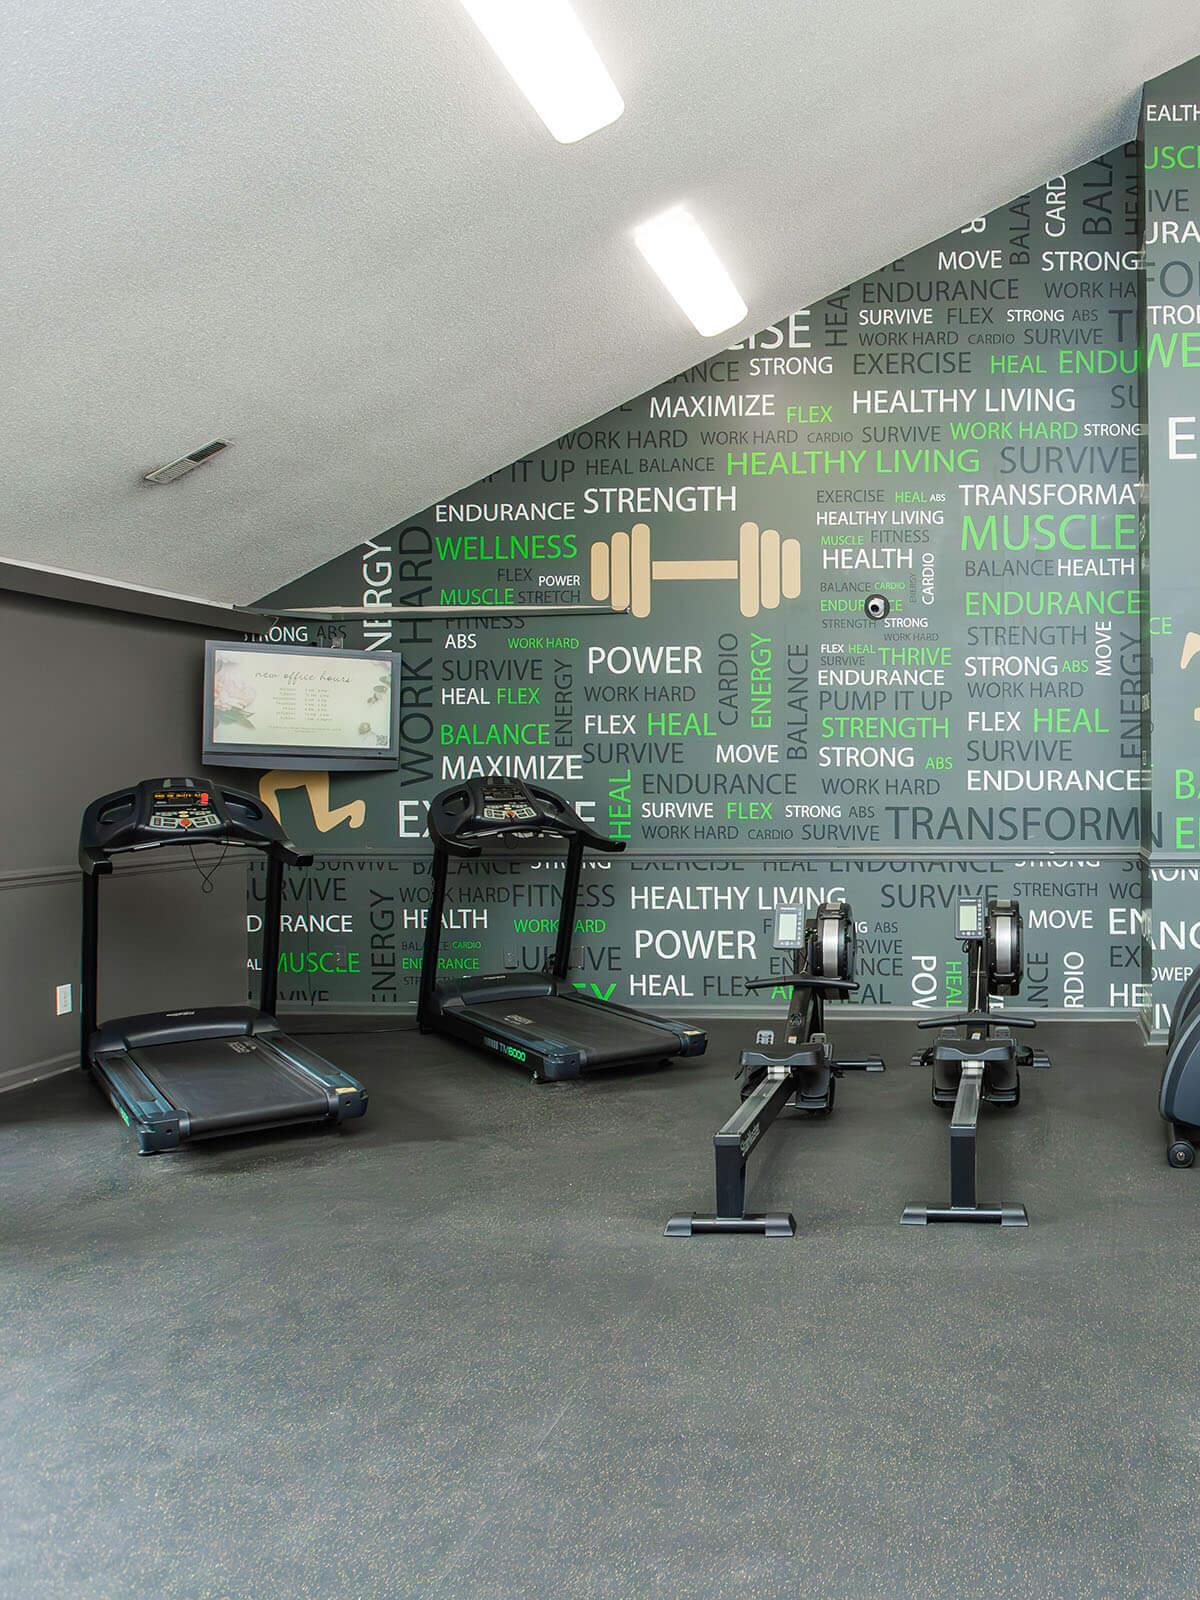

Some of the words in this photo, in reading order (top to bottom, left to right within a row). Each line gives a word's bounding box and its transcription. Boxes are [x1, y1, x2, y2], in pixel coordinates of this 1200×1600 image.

[938, 251, 1002, 269] MOVE
[1042, 251, 1139, 271] STRONG
[863, 279, 1019, 303] ENDURANCE
[1045, 282, 1103, 298] WORK
[859, 309, 933, 326] SURVIVE
[946, 308, 993, 324] FLEX
[1007, 309, 1064, 322] STRONG
[1073, 309, 1098, 322] ABS
[858, 332, 910, 345] WORK
[912, 331, 959, 345] HARD
[968, 334, 1014, 345] CARDIO
[1024, 329, 1103, 345] SURVIVE
[750, 357, 832, 376] STRONG
[853, 353, 971, 374] EXERCISE
[991, 355, 1047, 374] HEAL
[650, 394, 775, 418] MAXIMIZE
[852, 390, 976, 413] HEALTHY
[985, 388, 1076, 412] LIVING
[557, 431, 621, 450] WORK
[628, 429, 688, 448] HARD
[701, 431, 750, 445] WORK
[753, 430, 798, 444] HARD
[862, 426, 941, 443] SURVIVE
[950, 422, 1011, 440] WORK
[1019, 421, 1078, 438] HARD
[1084, 424, 1142, 436] STRONG
[585, 459, 633, 476] HEAL
[639, 457, 714, 473] BALANCE
[727, 451, 867, 476] HEALTHY
[877, 449, 980, 473] LIVING
[1000, 446, 1138, 474] SURVIVE
[511, 460, 533, 483] IT
[541, 459, 575, 482] UP
[583, 486, 737, 514] STRENGTH
[816, 489, 884, 503] EXERCISE
[895, 491, 927, 503] HEAL
[436, 503, 575, 523] ENDURANCE
[816, 512, 886, 526] HEALTHY
[891, 511, 944, 525] LIVING
[821, 536, 865, 545] MUSCLE
[870, 529, 929, 543] FITNESS
[961, 514, 1137, 550] MUSCLE
[436, 534, 577, 561] WELLNESS
[822, 549, 912, 569] HEALTH
[964, 560, 1054, 576] BALANCE
[1058, 558, 1135, 576] HEALTH
[497, 568, 533, 582] FLEX
[538, 575, 580, 587] POWER
[922, 553, 935, 605] CARDIO
[820, 581, 871, 593] BALANCE
[440, 589, 514, 606] MUSCLE
[518, 590, 580, 604] STRETCH
[966, 590, 1149, 616] ENDURANCE
[445, 634, 476, 649] ABS
[507, 638, 543, 649] WORK
[546, 637, 579, 649] HARD
[884, 633, 910, 641] WORK
[912, 633, 938, 641] HARD
[967, 626, 1087, 646] STRENGTH
[1096, 621, 1111, 676] MOVE
[588, 646, 702, 674] POWER
[718, 633, 738, 725] CARDIO
[751, 632, 772, 728] ENERGY
[818, 671, 944, 686] ENDURANCE
[442, 689, 490, 705] HEAL
[497, 688, 540, 704] FLEX
[585, 687, 642, 702] WORK
[644, 687, 696, 701] HARD
[968, 683, 1024, 698] WORK
[1030, 681, 1083, 697] HARD
[1120, 632, 1142, 758] ENERGY
[554, 659, 573, 747] ENERGY
[787, 644, 808, 760] BALANCE
[820, 691, 886, 711] PUMP
[895, 690, 913, 710] IT
[921, 691, 953, 711] UP
[585, 715, 635, 734] FLEX
[648, 713, 717, 737] HEAL
[822, 718, 949, 738] STRENGTH
[968, 711, 1021, 732] FLEX
[1033, 709, 1109, 733] HEAL
[441, 724, 550, 745] BALANCE
[583, 743, 683, 764] SURVIVE
[716, 745, 779, 763] MOVE
[819, 747, 915, 768] STRONG
[967, 740, 1072, 761] SURVIVE
[642, 773, 797, 795] ENDURANCE
[822, 778, 879, 794] WORK
[886, 779, 940, 795] HARD
[967, 770, 1147, 791] ENDURANCE
[609, 770, 632, 839] HEAL
[642, 803, 713, 818] SURVIVE
[727, 803, 772, 819] FLEX
[785, 805, 841, 817] STRONG
[642, 825, 692, 840] WORK
[694, 825, 739, 839] HARD
[748, 829, 793, 840] CARDIO
[802, 824, 880, 841] SURVIVE
[459, 888, 509, 903] HARD
[630, 886, 750, 910] HEALTHY
[1014, 882, 1097, 897] STRENGTH
[1028, 910, 1093, 929] MOVE
[635, 930, 756, 959] POWER
[630, 975, 693, 997] HEAL
[945, 961, 962, 1008] HEAL
